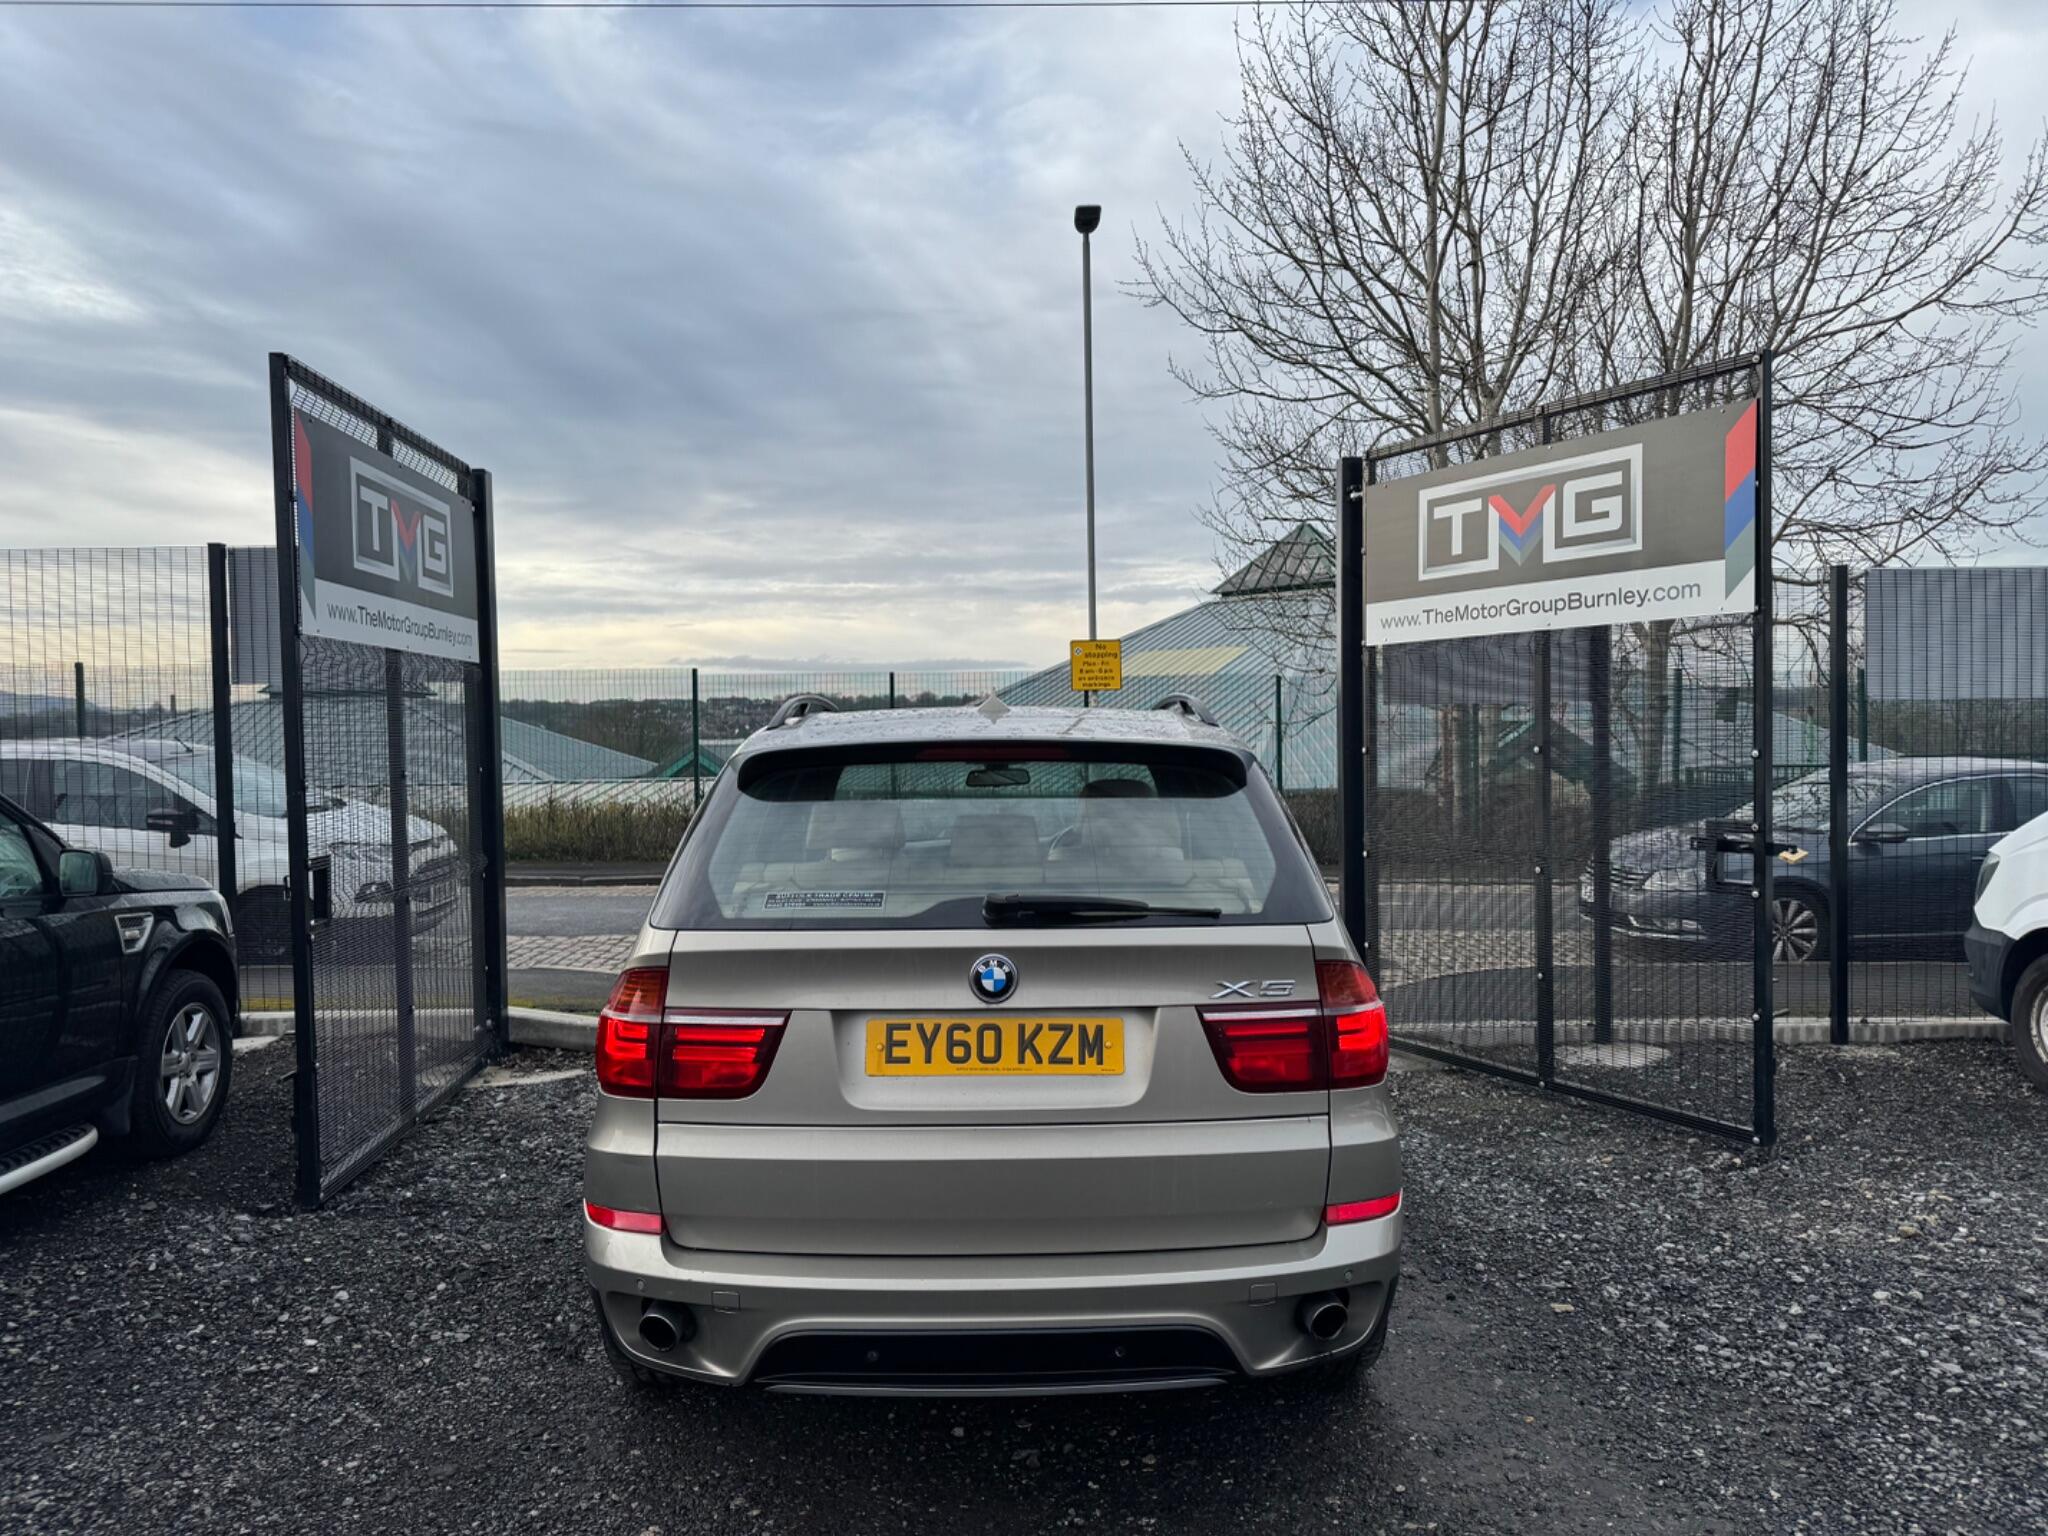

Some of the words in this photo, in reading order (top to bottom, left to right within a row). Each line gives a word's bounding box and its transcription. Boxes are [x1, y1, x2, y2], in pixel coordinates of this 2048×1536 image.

[359, 484, 448, 588] TMG
[1433, 470, 1623, 570] TMG
[327, 602, 473, 648] www.TheMotorGroupBurnley.com
[1380, 581, 1701, 630] www.TheMotorGroupBurnley.com
[1208, 979, 1296, 1000] X5
[884, 1022, 1002, 1065] EY60
[1018, 1023, 1105, 1066] KZM
